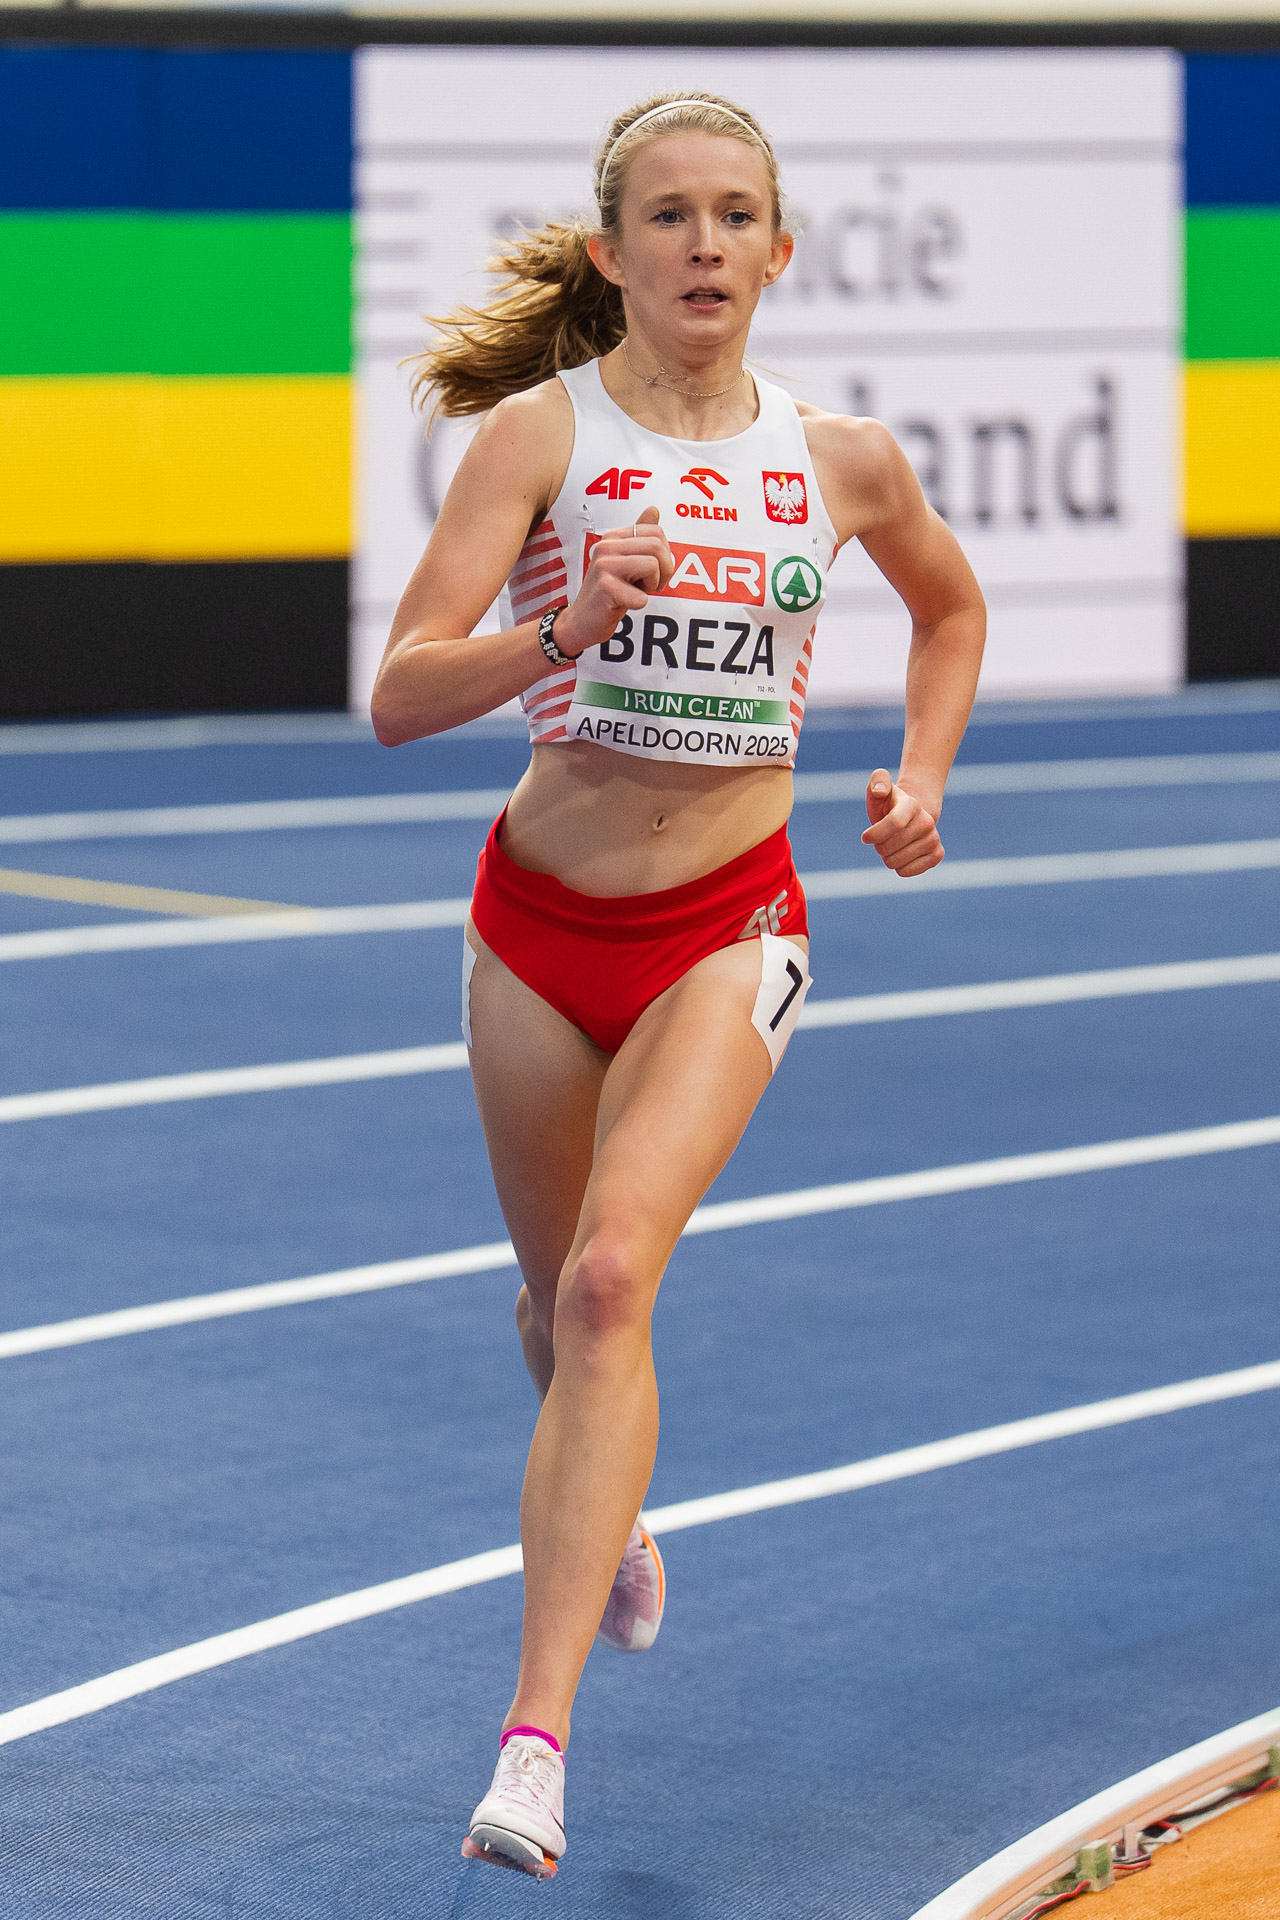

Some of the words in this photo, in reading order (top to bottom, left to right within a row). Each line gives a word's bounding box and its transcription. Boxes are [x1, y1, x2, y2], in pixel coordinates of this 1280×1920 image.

[585, 467, 653, 500] 4F
[676, 503, 738, 522] ORLEN
[600, 614, 775, 676] BREZA
[624, 690, 630, 708] I
[635, 692, 683, 714] RUN
[577, 716, 741, 755] APELDOORN
[744, 735, 789, 757] 2025
[737, 889, 789, 940] 4F
[768, 958, 804, 1032] 7
